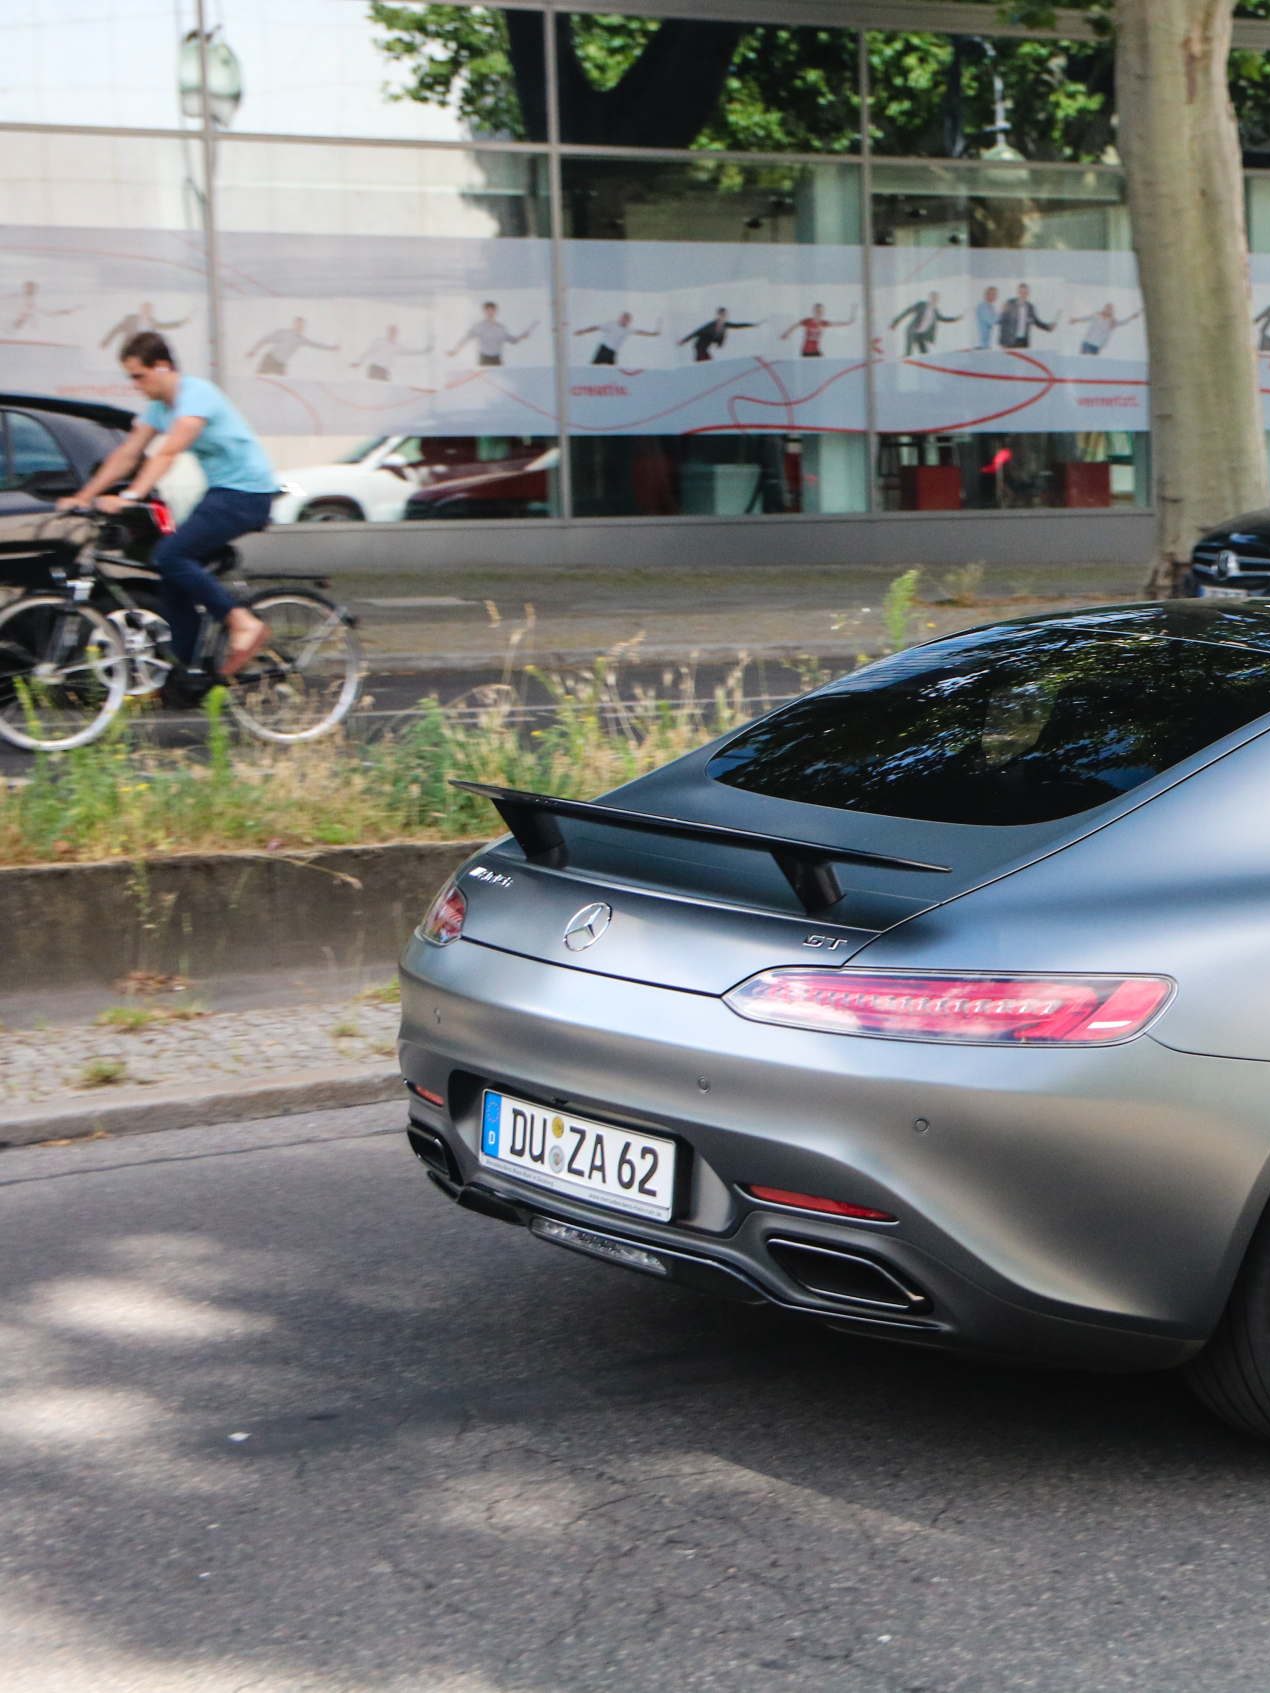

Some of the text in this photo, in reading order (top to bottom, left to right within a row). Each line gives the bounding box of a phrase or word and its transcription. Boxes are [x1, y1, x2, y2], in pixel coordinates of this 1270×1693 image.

[488, 1130, 496, 1145] D
[510, 1107, 659, 1198] DU ZA 62
